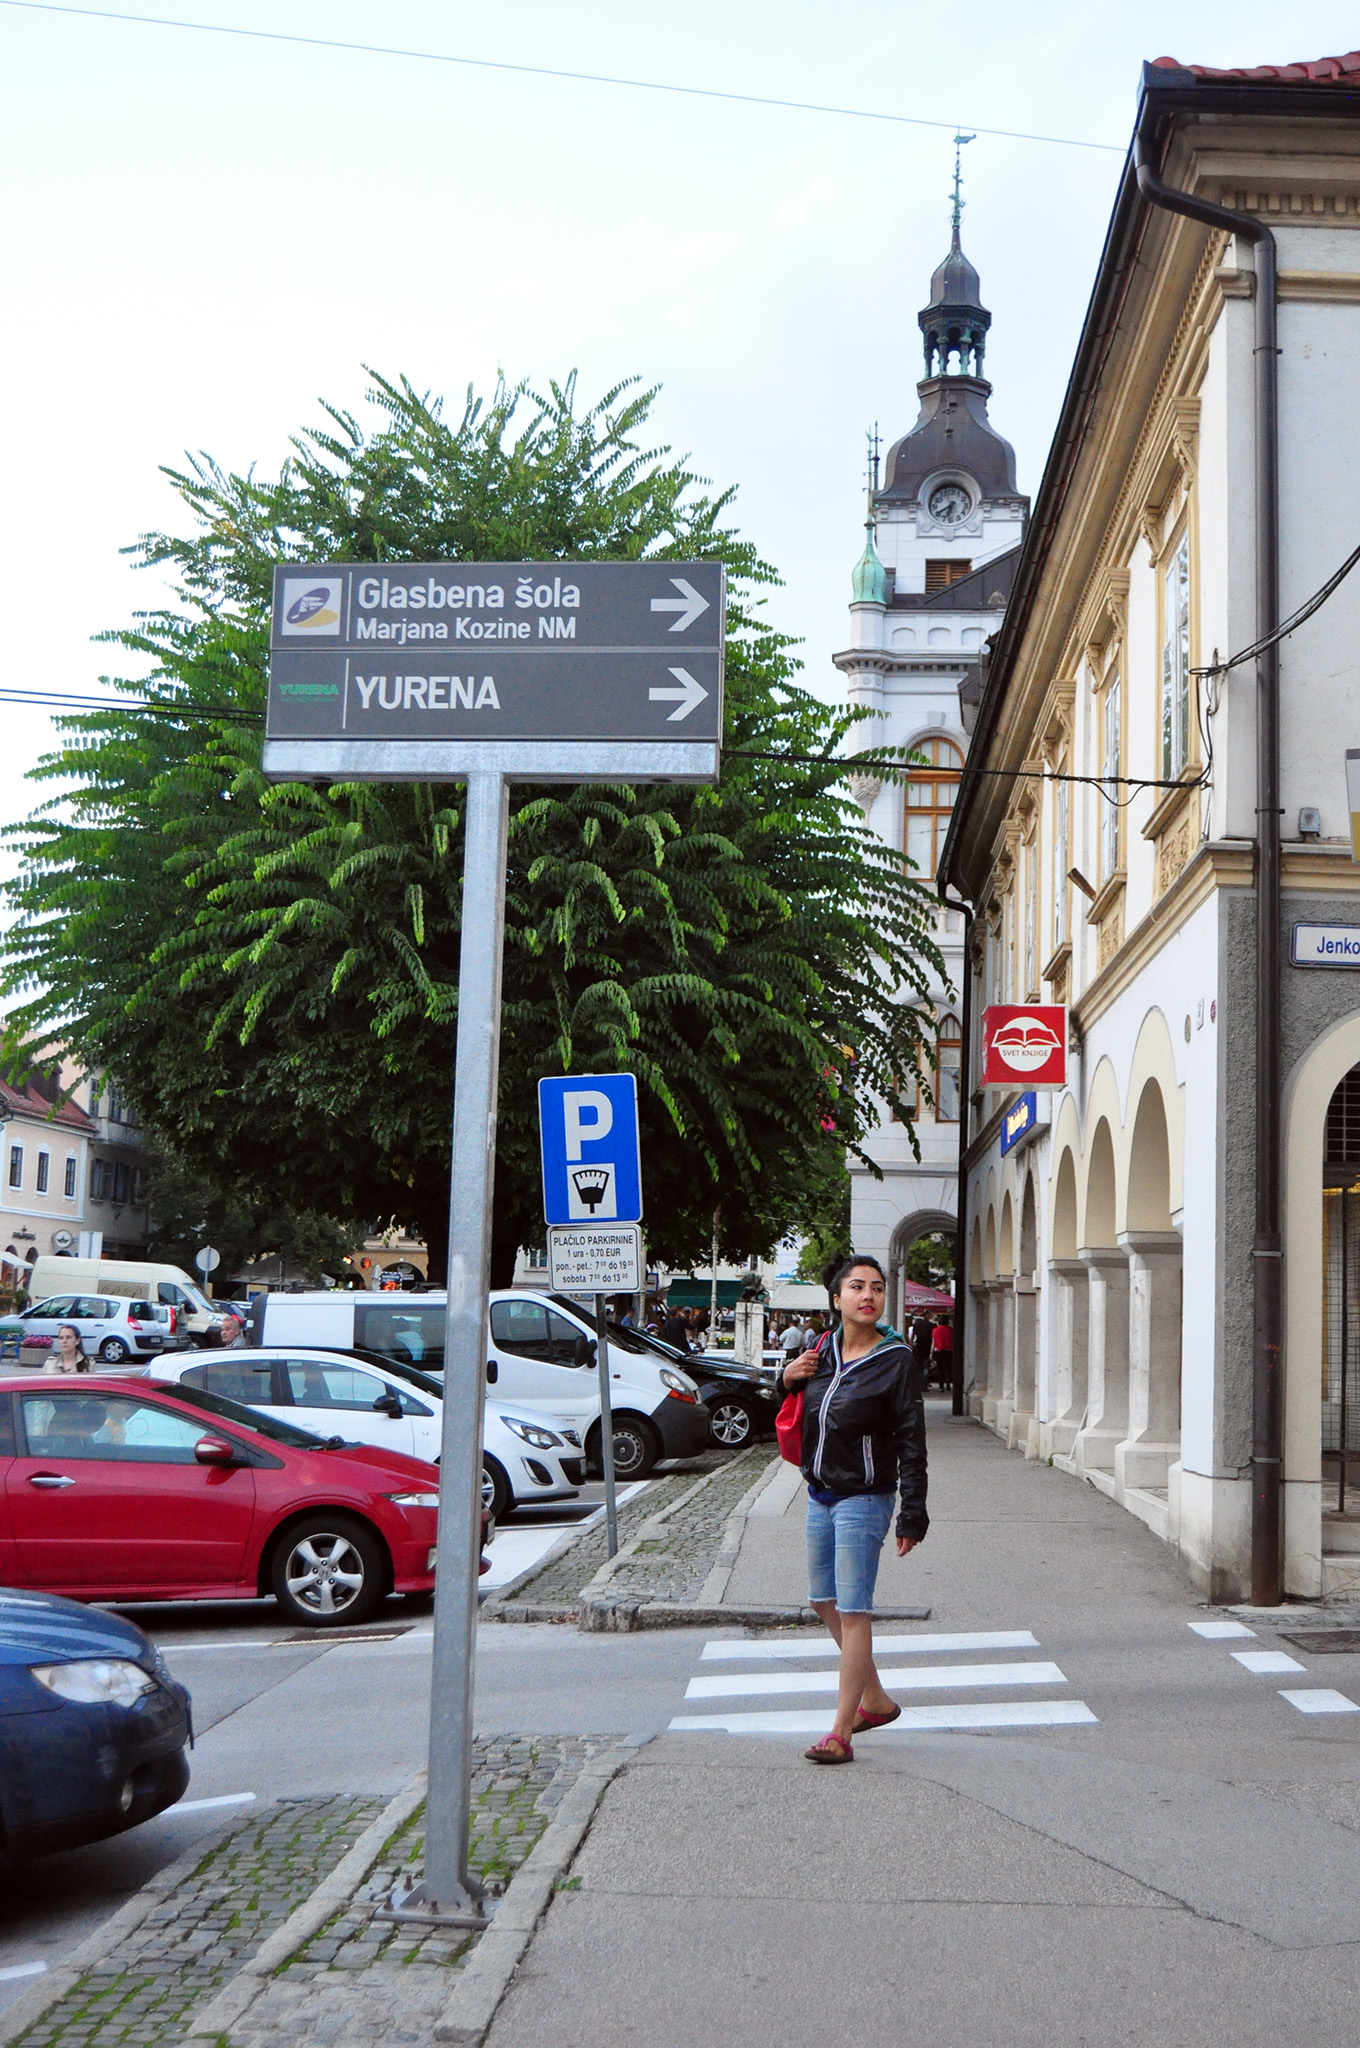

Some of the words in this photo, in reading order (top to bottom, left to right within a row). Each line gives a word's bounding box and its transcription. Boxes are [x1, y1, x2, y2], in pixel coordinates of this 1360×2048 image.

[358, 577, 505, 609] Glasbena
[515, 577, 581, 608] šola
[356, 617, 449, 645] Marjana
[455, 617, 531, 639] Kozine
[538, 616, 576, 639] NM
[355, 676, 501, 710] YURENA
[1021, 1049, 1048, 1057] KNJIGE
[563, 1090, 613, 1162] P
[553, 1234, 586, 1246] PLAČILO
[587, 1235, 634, 1245] PARKIRNINE
[573, 1250, 584, 1258] ura
[590, 1248, 604, 1258] 0,70
[605, 1248, 621, 1257] EUR
[608, 1261, 618, 1270] do
[562, 1274, 586, 1283] sobota
[602, 1274, 611, 1283] do
